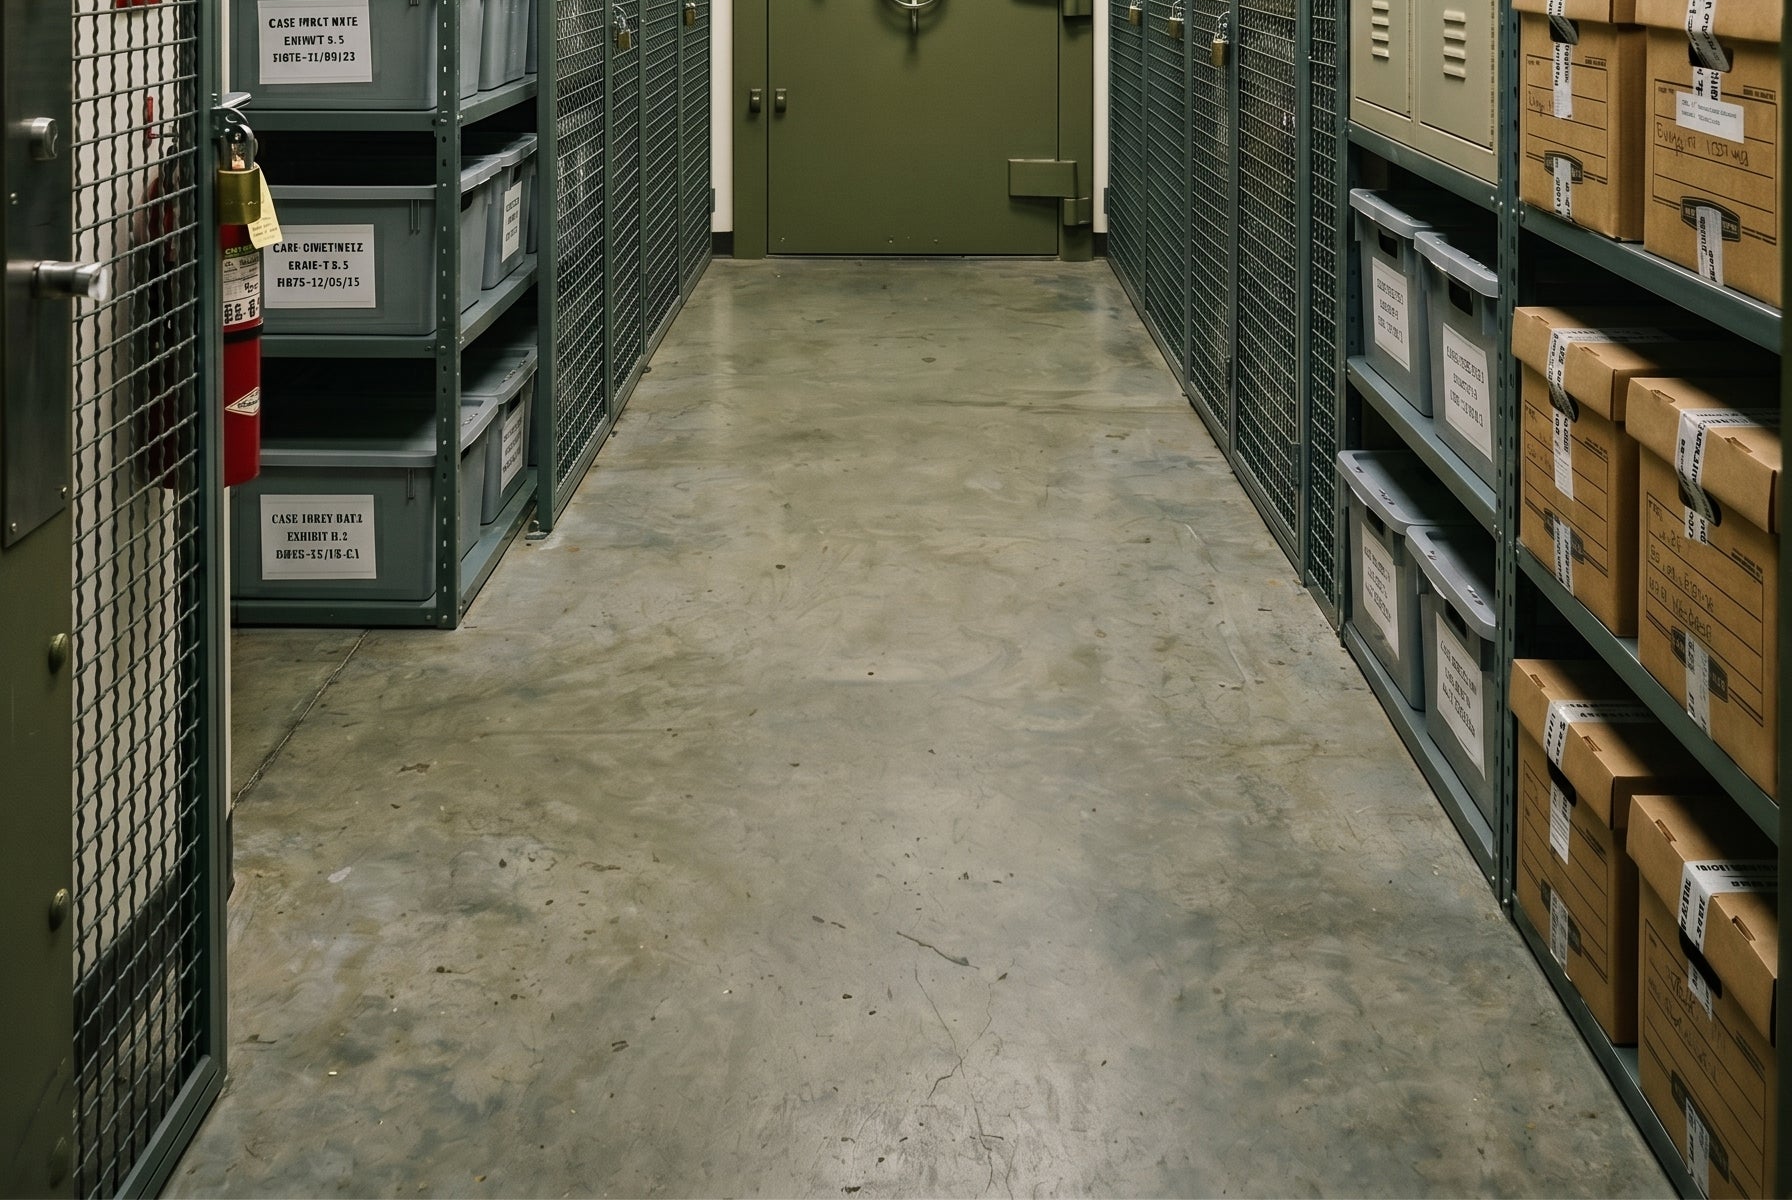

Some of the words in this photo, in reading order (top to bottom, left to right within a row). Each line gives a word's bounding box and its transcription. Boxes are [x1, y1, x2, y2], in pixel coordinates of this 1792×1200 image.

[268, 18, 296, 29] CASE
[271, 513, 298, 524] CASE
[287, 531, 328, 542] EXHIBIT
